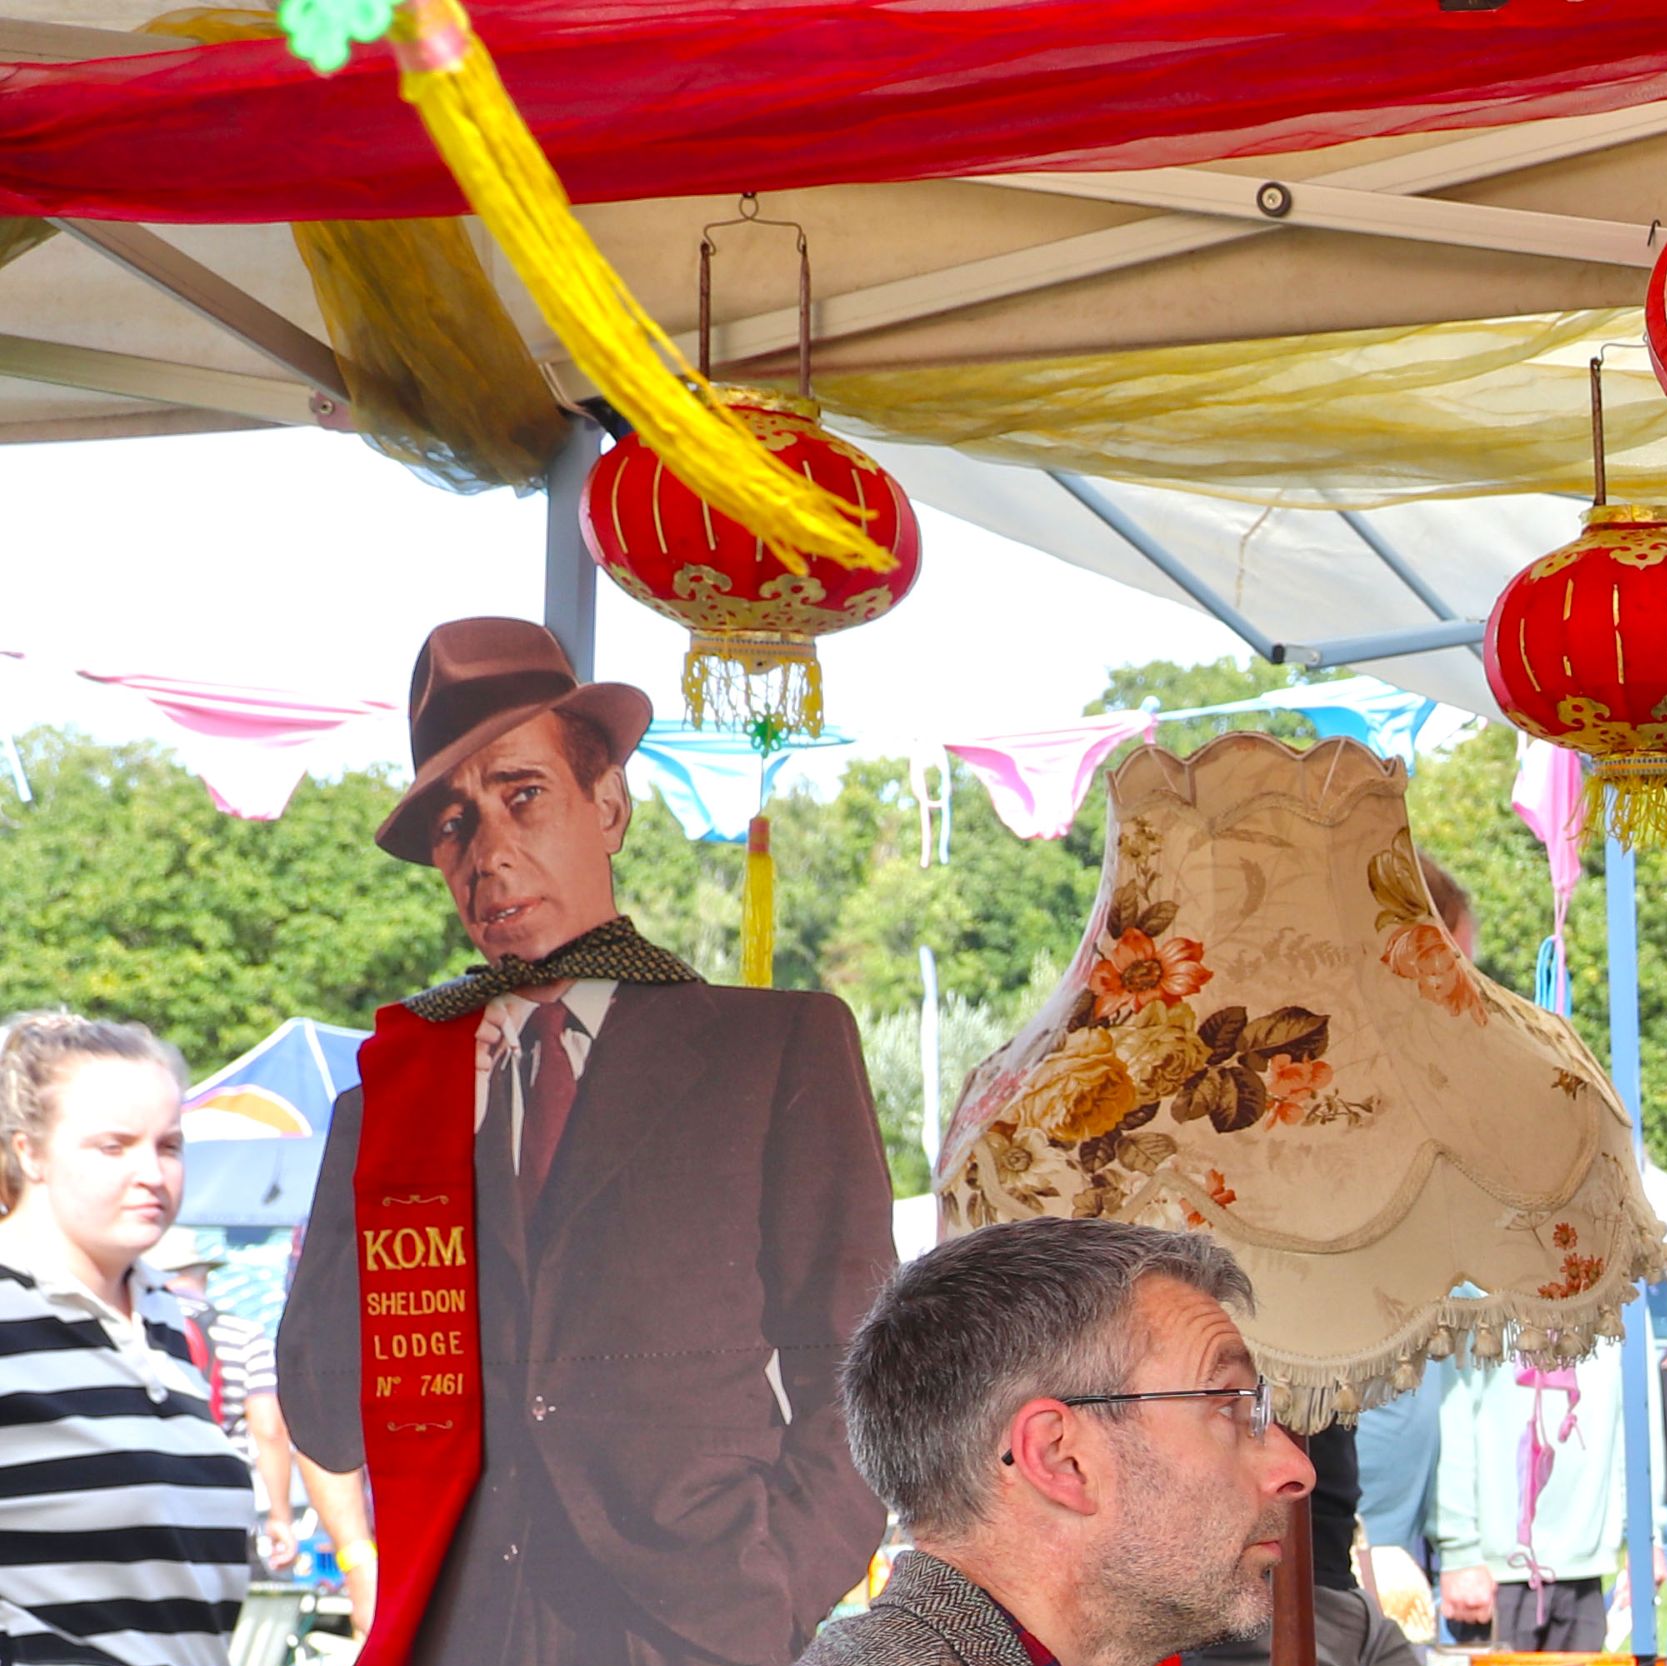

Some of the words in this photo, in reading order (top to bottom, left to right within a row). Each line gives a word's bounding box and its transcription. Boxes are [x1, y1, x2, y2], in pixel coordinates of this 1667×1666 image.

[367, 1289, 466, 1316] SHELDON
[373, 1331, 464, 1360] LODGE
[420, 1373, 463, 1395] 7461
